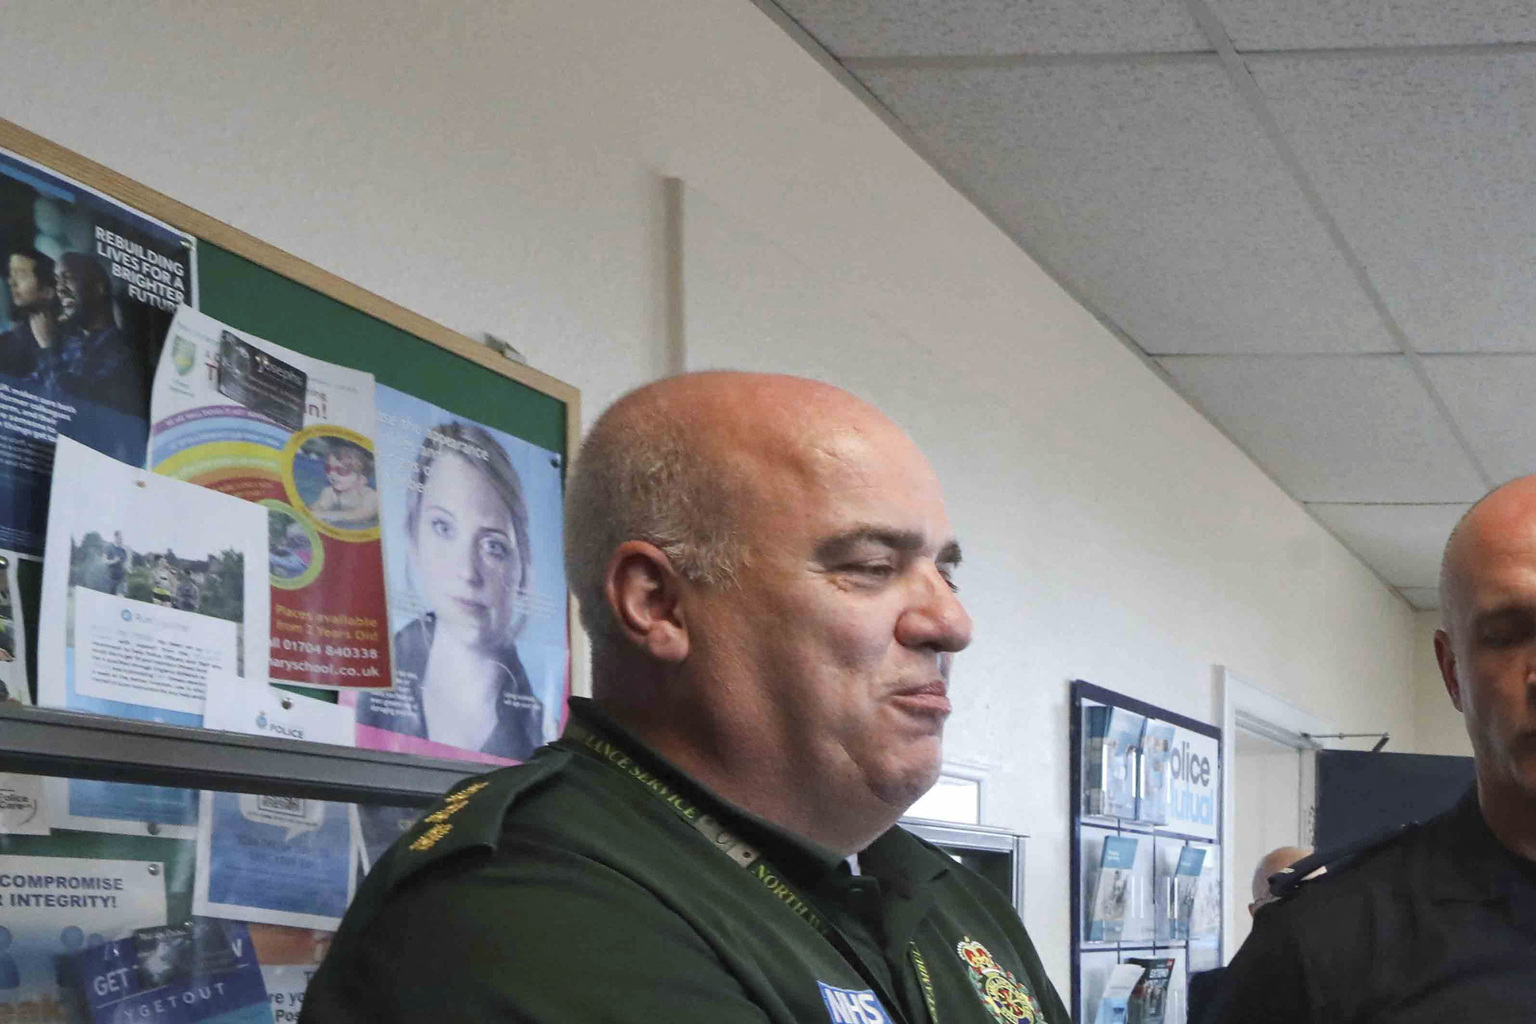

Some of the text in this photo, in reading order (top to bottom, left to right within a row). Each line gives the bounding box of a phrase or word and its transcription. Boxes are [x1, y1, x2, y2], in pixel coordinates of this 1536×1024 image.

[95, 225, 185, 277] REBUILDING
[97, 241, 186, 292] LIVES FOR A
[112, 262, 185, 305] BRIGHTER
[128, 283, 178, 314] FUTUR
[275, 604, 378, 628] Places available
[282, 639, 322, 656] 01704
[324, 644, 379, 660] 840338
[270, 658, 380, 677] aryschool.co.uk
[270, 723, 304, 740] POLICE
[1171, 740, 1211, 788] olice
[0, 873, 124, 891] COMPROMISE
[10, 893, 118, 909] INTEGRITY!
[93, 967, 130, 996] GET
